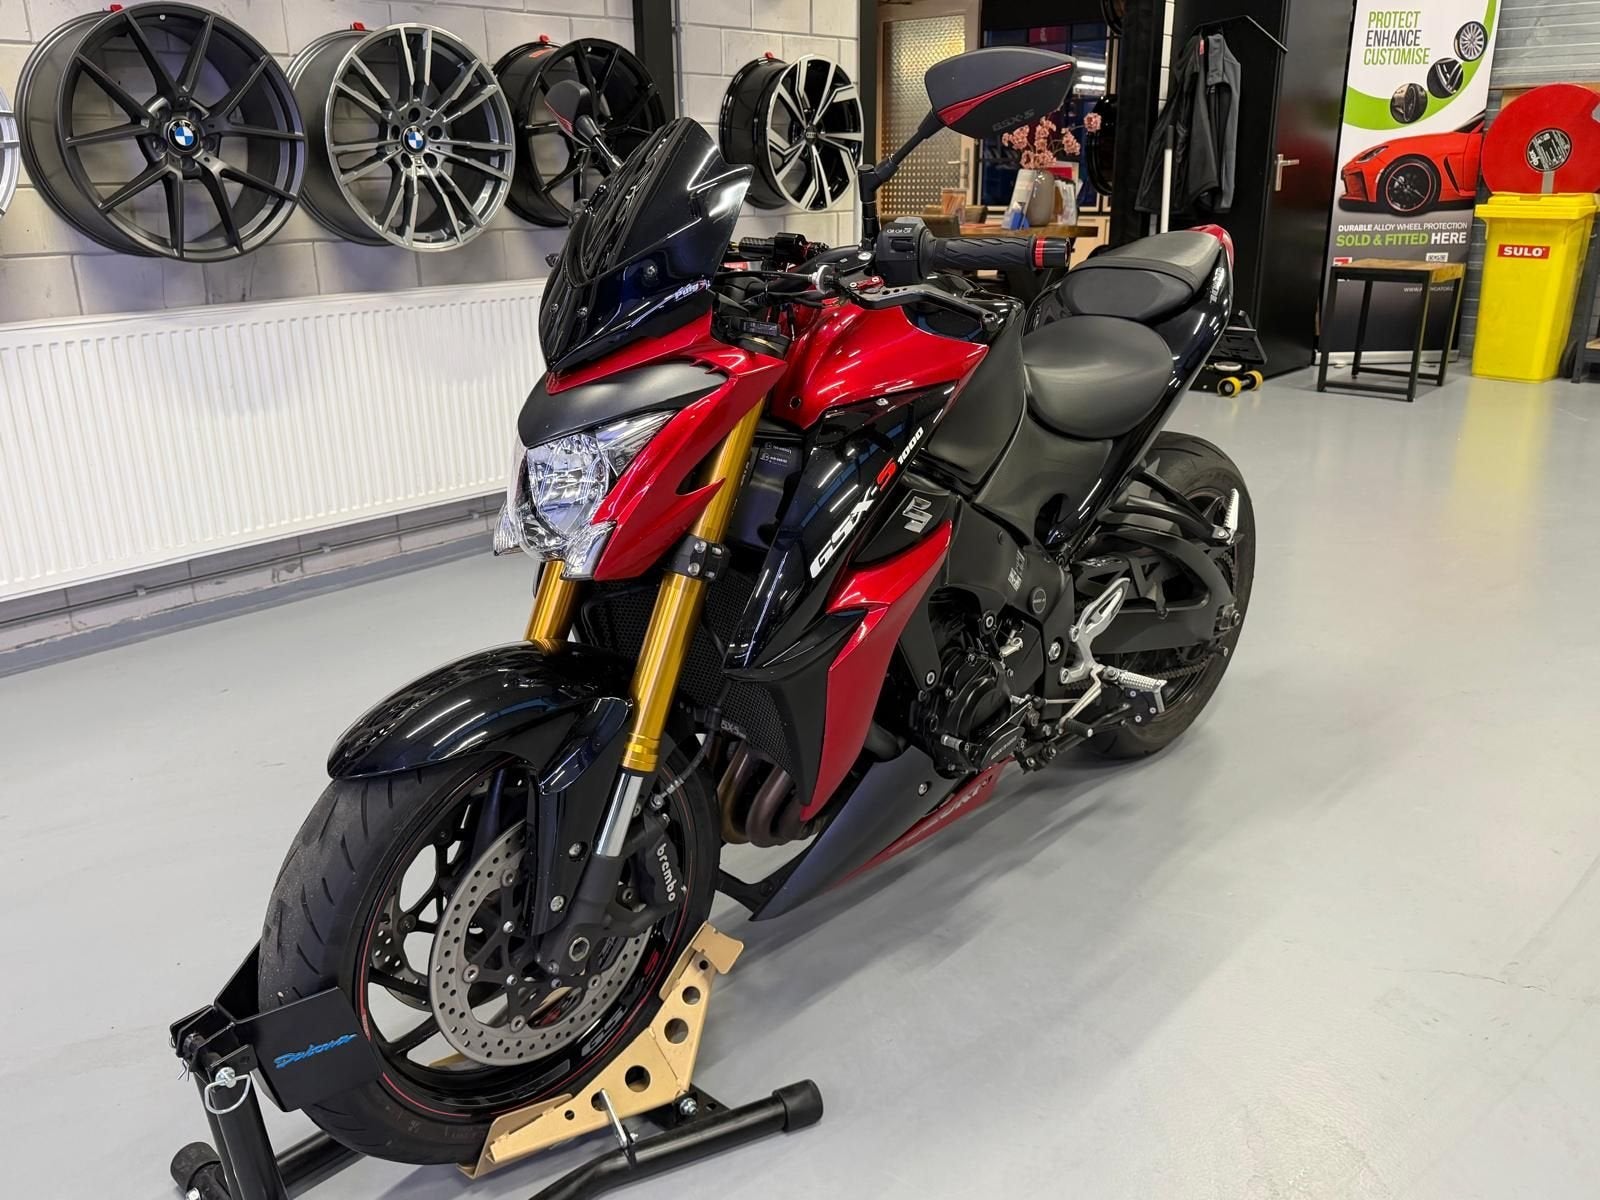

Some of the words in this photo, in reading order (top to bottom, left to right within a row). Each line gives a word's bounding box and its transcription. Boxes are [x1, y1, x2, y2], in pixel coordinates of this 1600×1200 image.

[1367, 11, 1421, 28] PROTECT
[1366, 29, 1422, 47] ENHANCE
[1363, 48, 1430, 65] CUSTOMISE
[1338, 223, 1373, 232] DURABLE
[1373, 223, 1395, 231] ALLOY
[1396, 222, 1422, 231] WHEEL
[1423, 221, 1467, 230] PROTECTION
[1336, 233, 1371, 247] SOLD
[1373, 233, 1383, 246] &
[1385, 232, 1429, 246] FITTED
[1430, 232, 1467, 245] HERE
[1503, 246, 1543, 257] SULO
[809, 457, 897, 579] GSX-S
[897, 426, 924, 465] 1000
[656, 842, 678, 902] brembo
